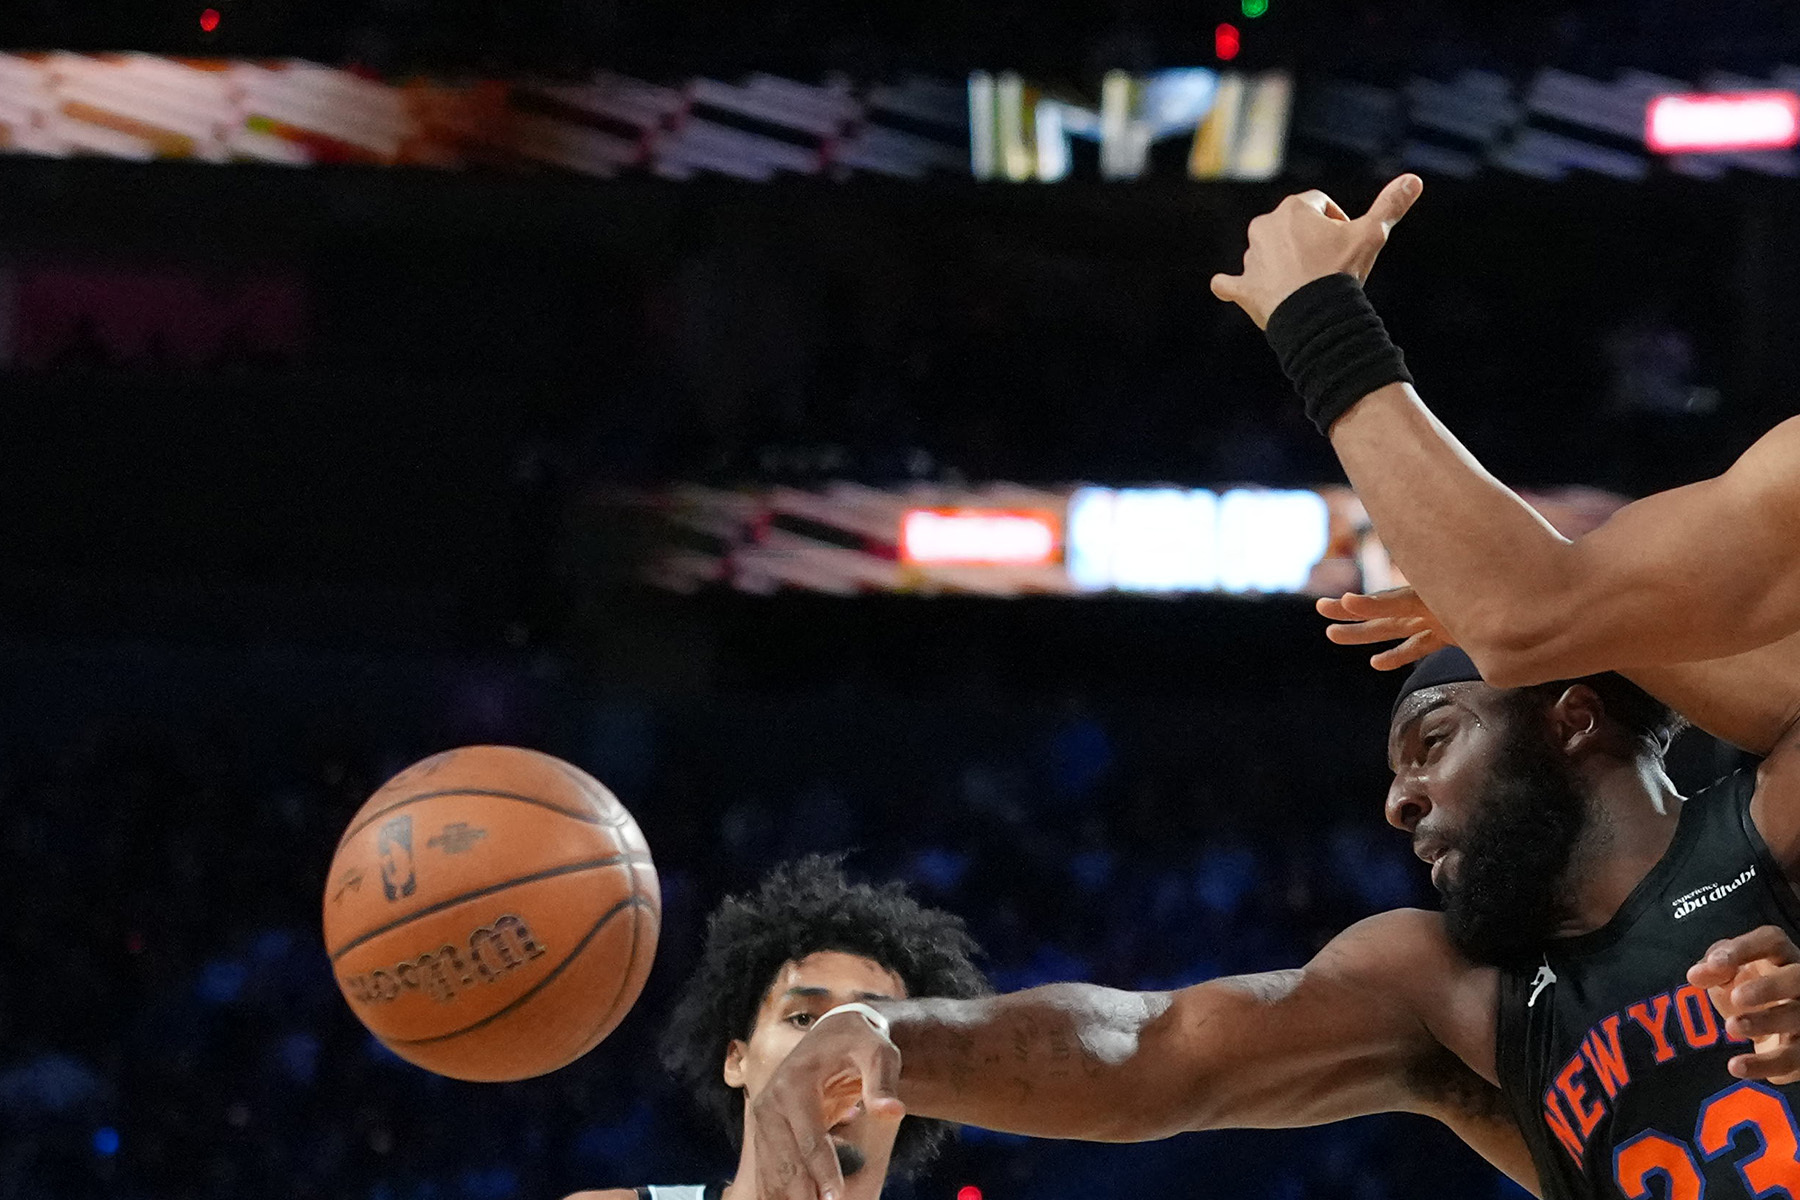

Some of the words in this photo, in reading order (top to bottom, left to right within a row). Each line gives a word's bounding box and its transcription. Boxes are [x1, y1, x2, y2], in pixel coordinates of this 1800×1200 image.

[1672, 883, 1718, 906] experience
[1674, 895, 1707, 919] abu
[1709, 865, 1756, 901] dhabi
[1544, 1014, 1630, 1171] NEW
[1627, 984, 1752, 1064] YO
